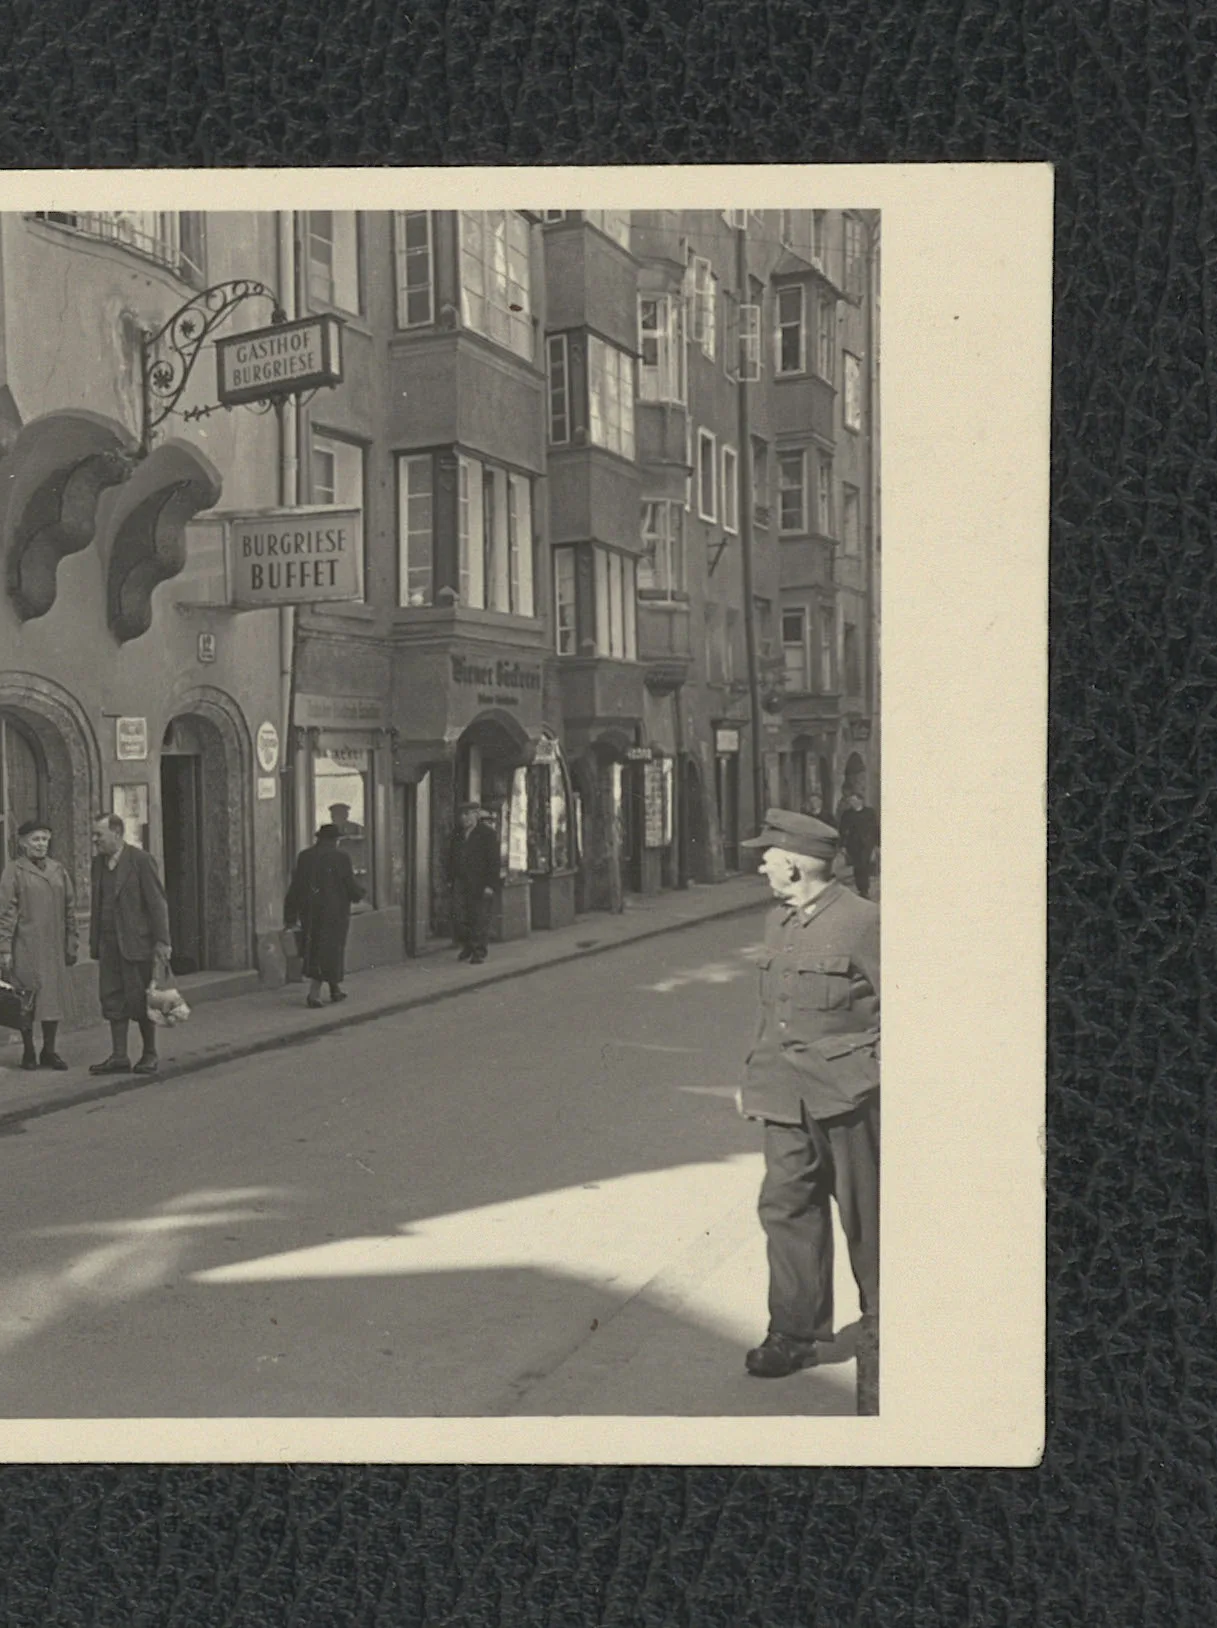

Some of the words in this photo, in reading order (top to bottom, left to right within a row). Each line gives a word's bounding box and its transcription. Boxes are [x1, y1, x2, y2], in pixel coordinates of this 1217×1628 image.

[236, 331, 312, 364] GASTHOF
[233, 351, 315, 387] BURGRIESE
[242, 528, 347, 558] BURGRIESE
[251, 558, 339, 591] BUFFET
